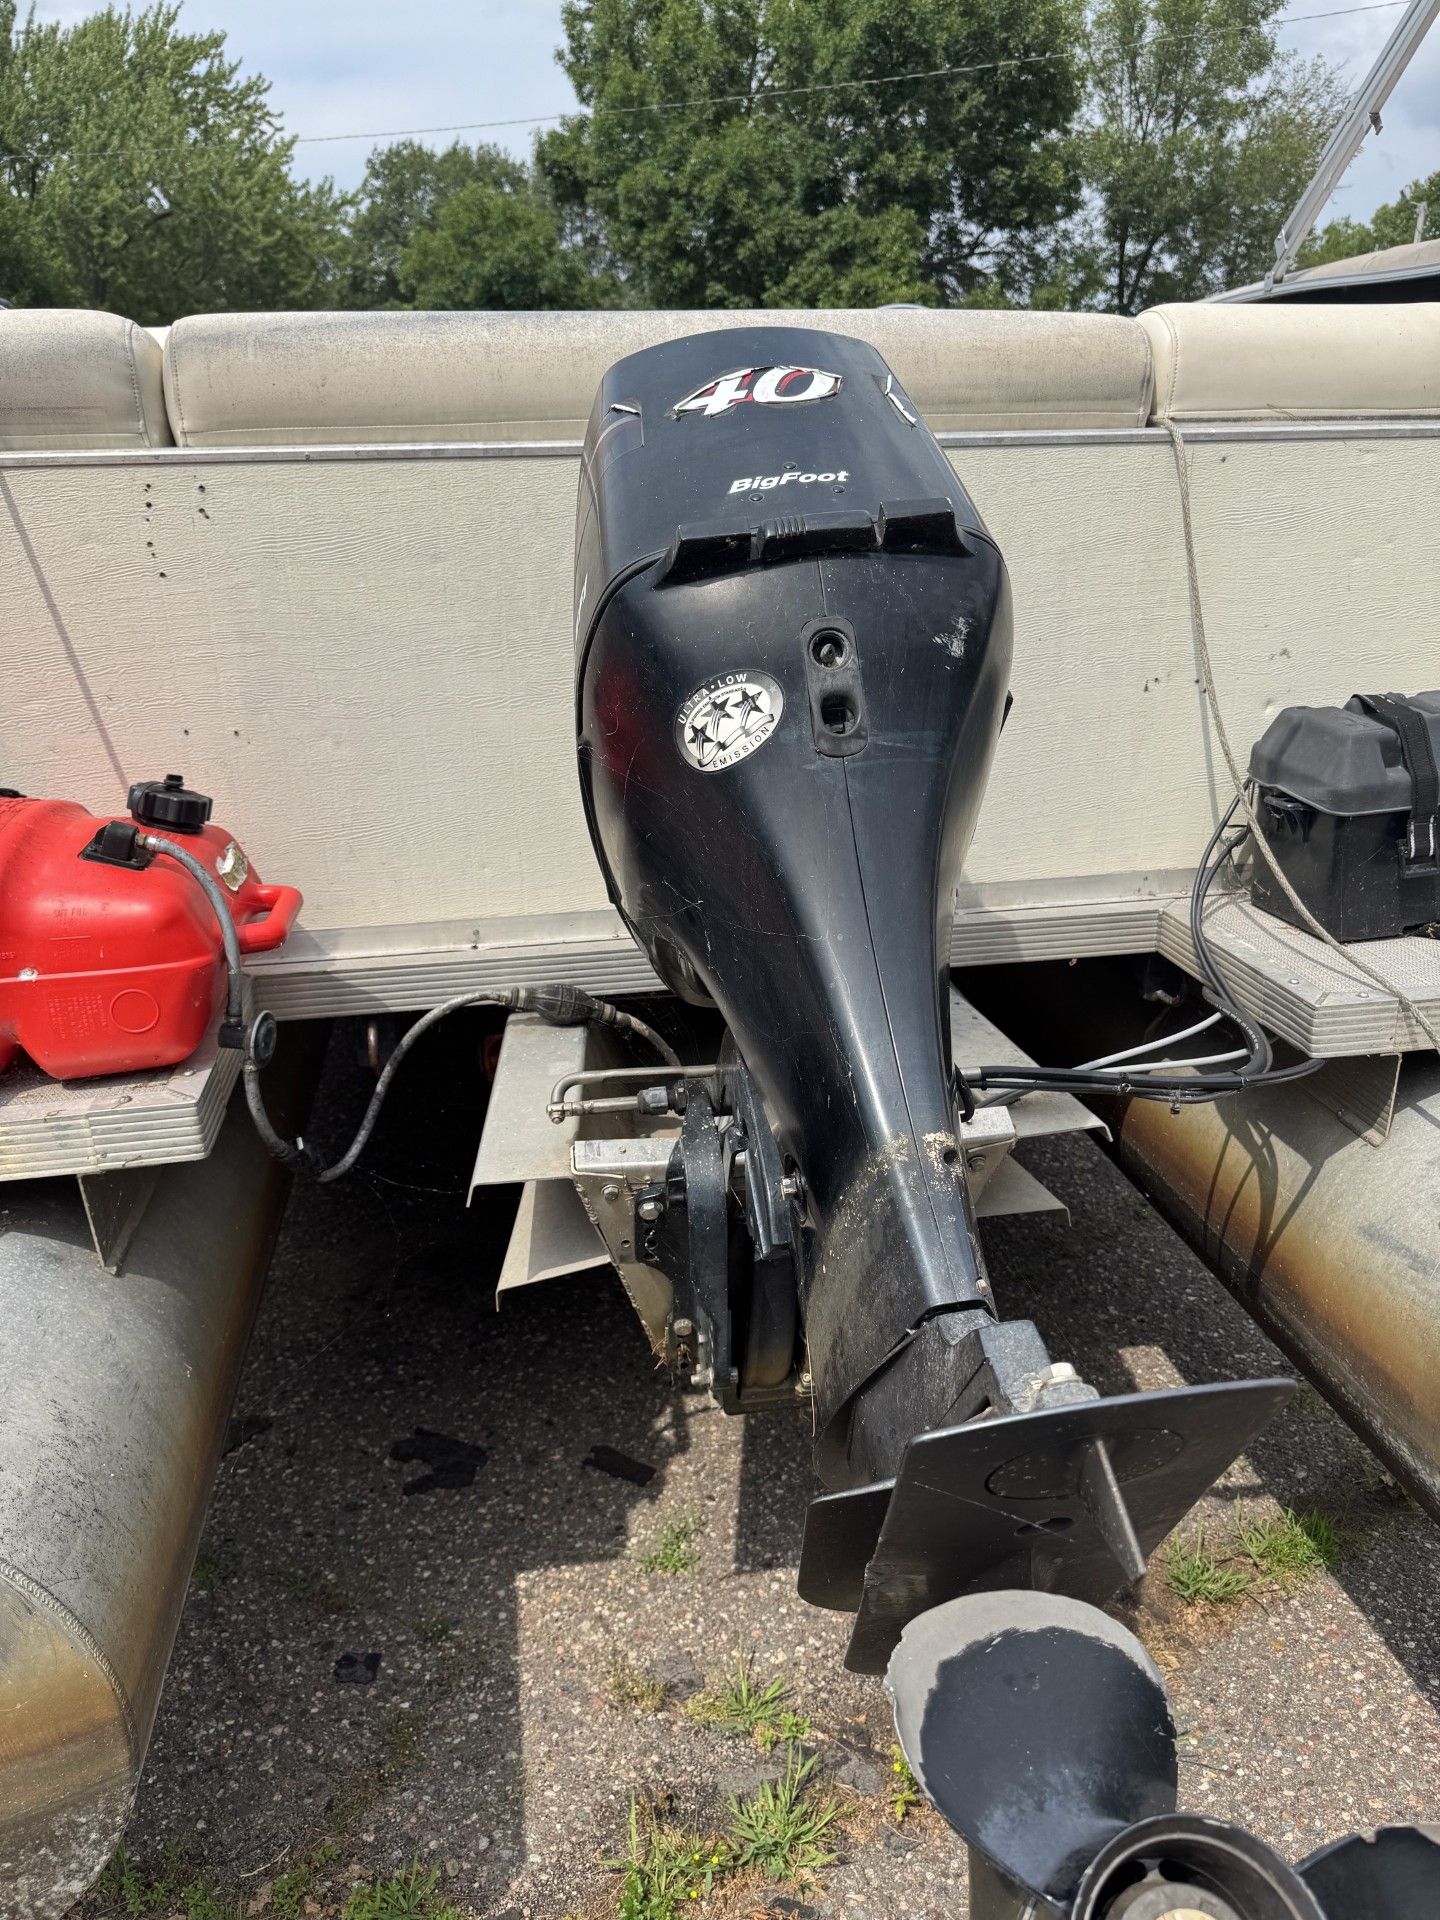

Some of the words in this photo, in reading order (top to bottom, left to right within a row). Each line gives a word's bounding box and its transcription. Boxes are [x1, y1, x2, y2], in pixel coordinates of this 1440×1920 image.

[673, 365, 844, 418] 40
[728, 470, 850, 494] BigFoot
[678, 688, 710, 725] ULTRA
[717, 673, 747, 687] LOW
[712, 726, 770, 768] EMISSION
